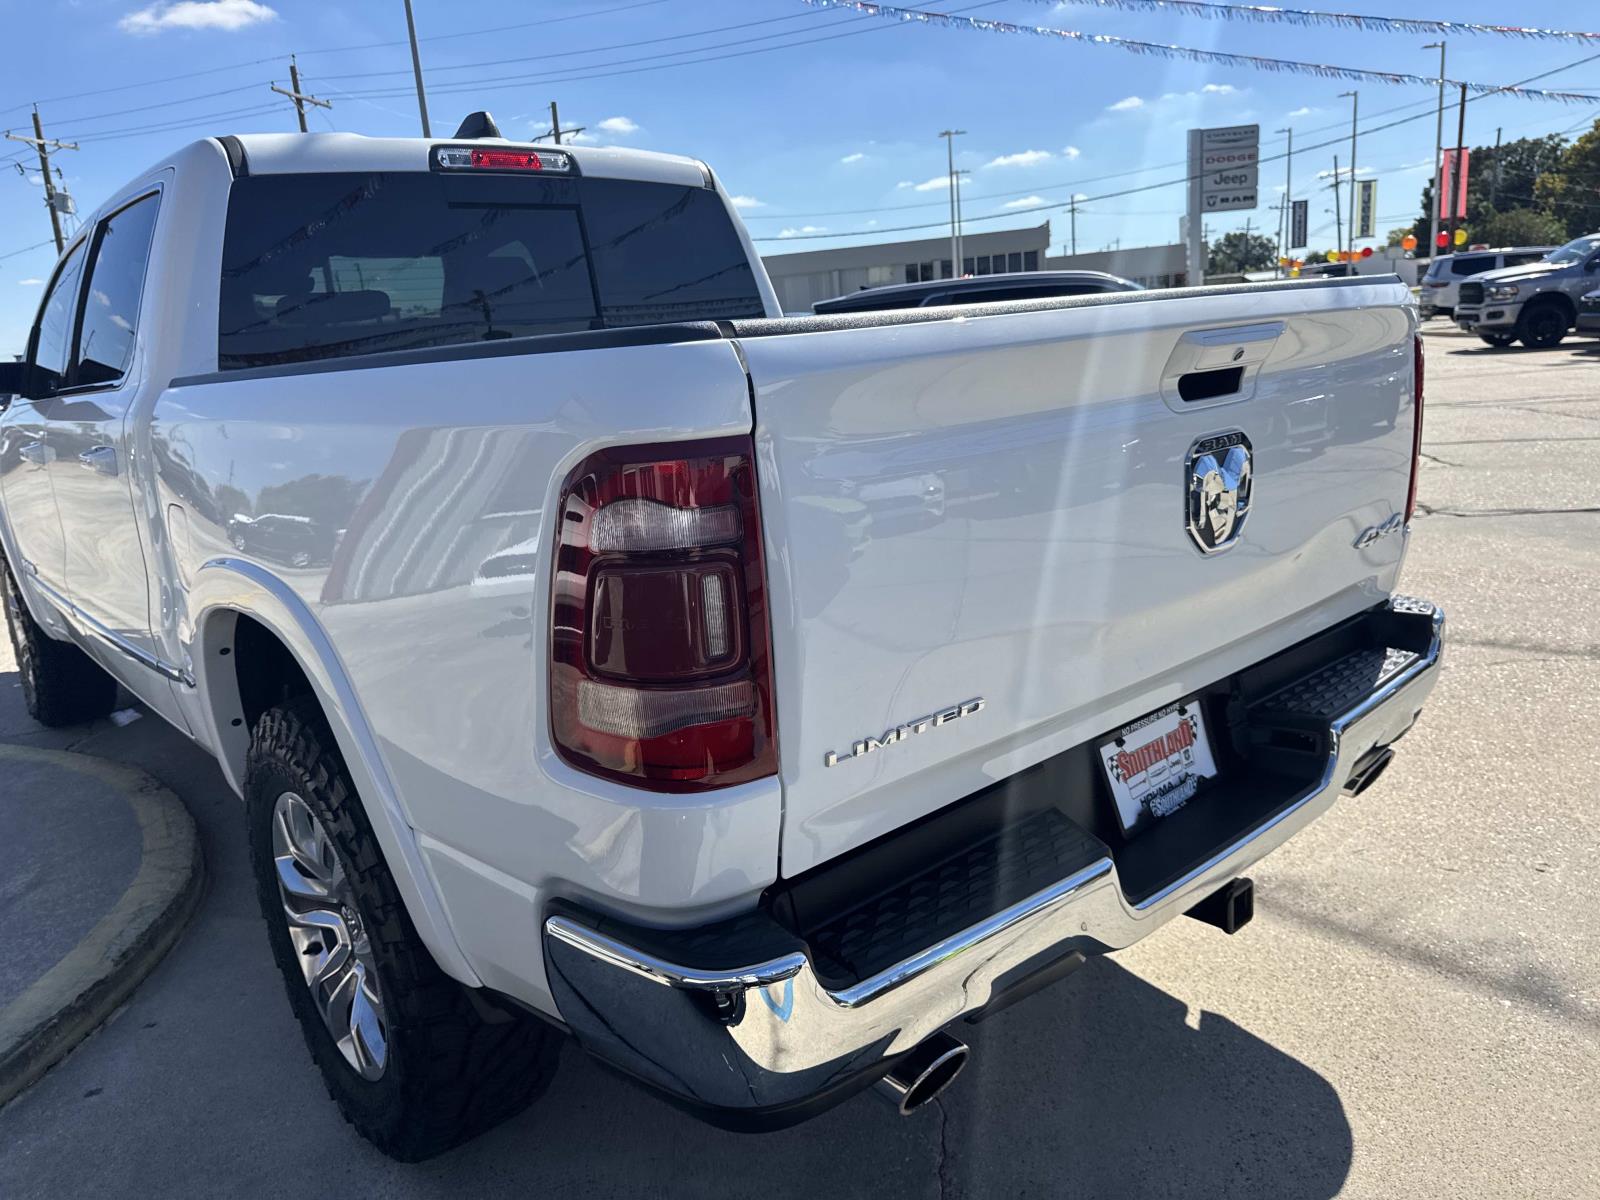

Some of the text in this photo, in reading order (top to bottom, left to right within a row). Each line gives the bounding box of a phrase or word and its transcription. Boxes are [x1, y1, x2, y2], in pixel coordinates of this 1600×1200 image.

[1205, 153, 1256, 164] DODGE
[1213, 172, 1248, 186] Jeep
[1220, 195, 1255, 203] RAM
[1203, 432, 1242, 451] RAM
[824, 696, 985, 767] LIMITED
[1121, 727, 1131, 737] NO
[1130, 711, 1158, 732] PRESSURE
[1158, 708, 1167, 719] NO
[1116, 719, 1194, 784] SOUTHLAND
